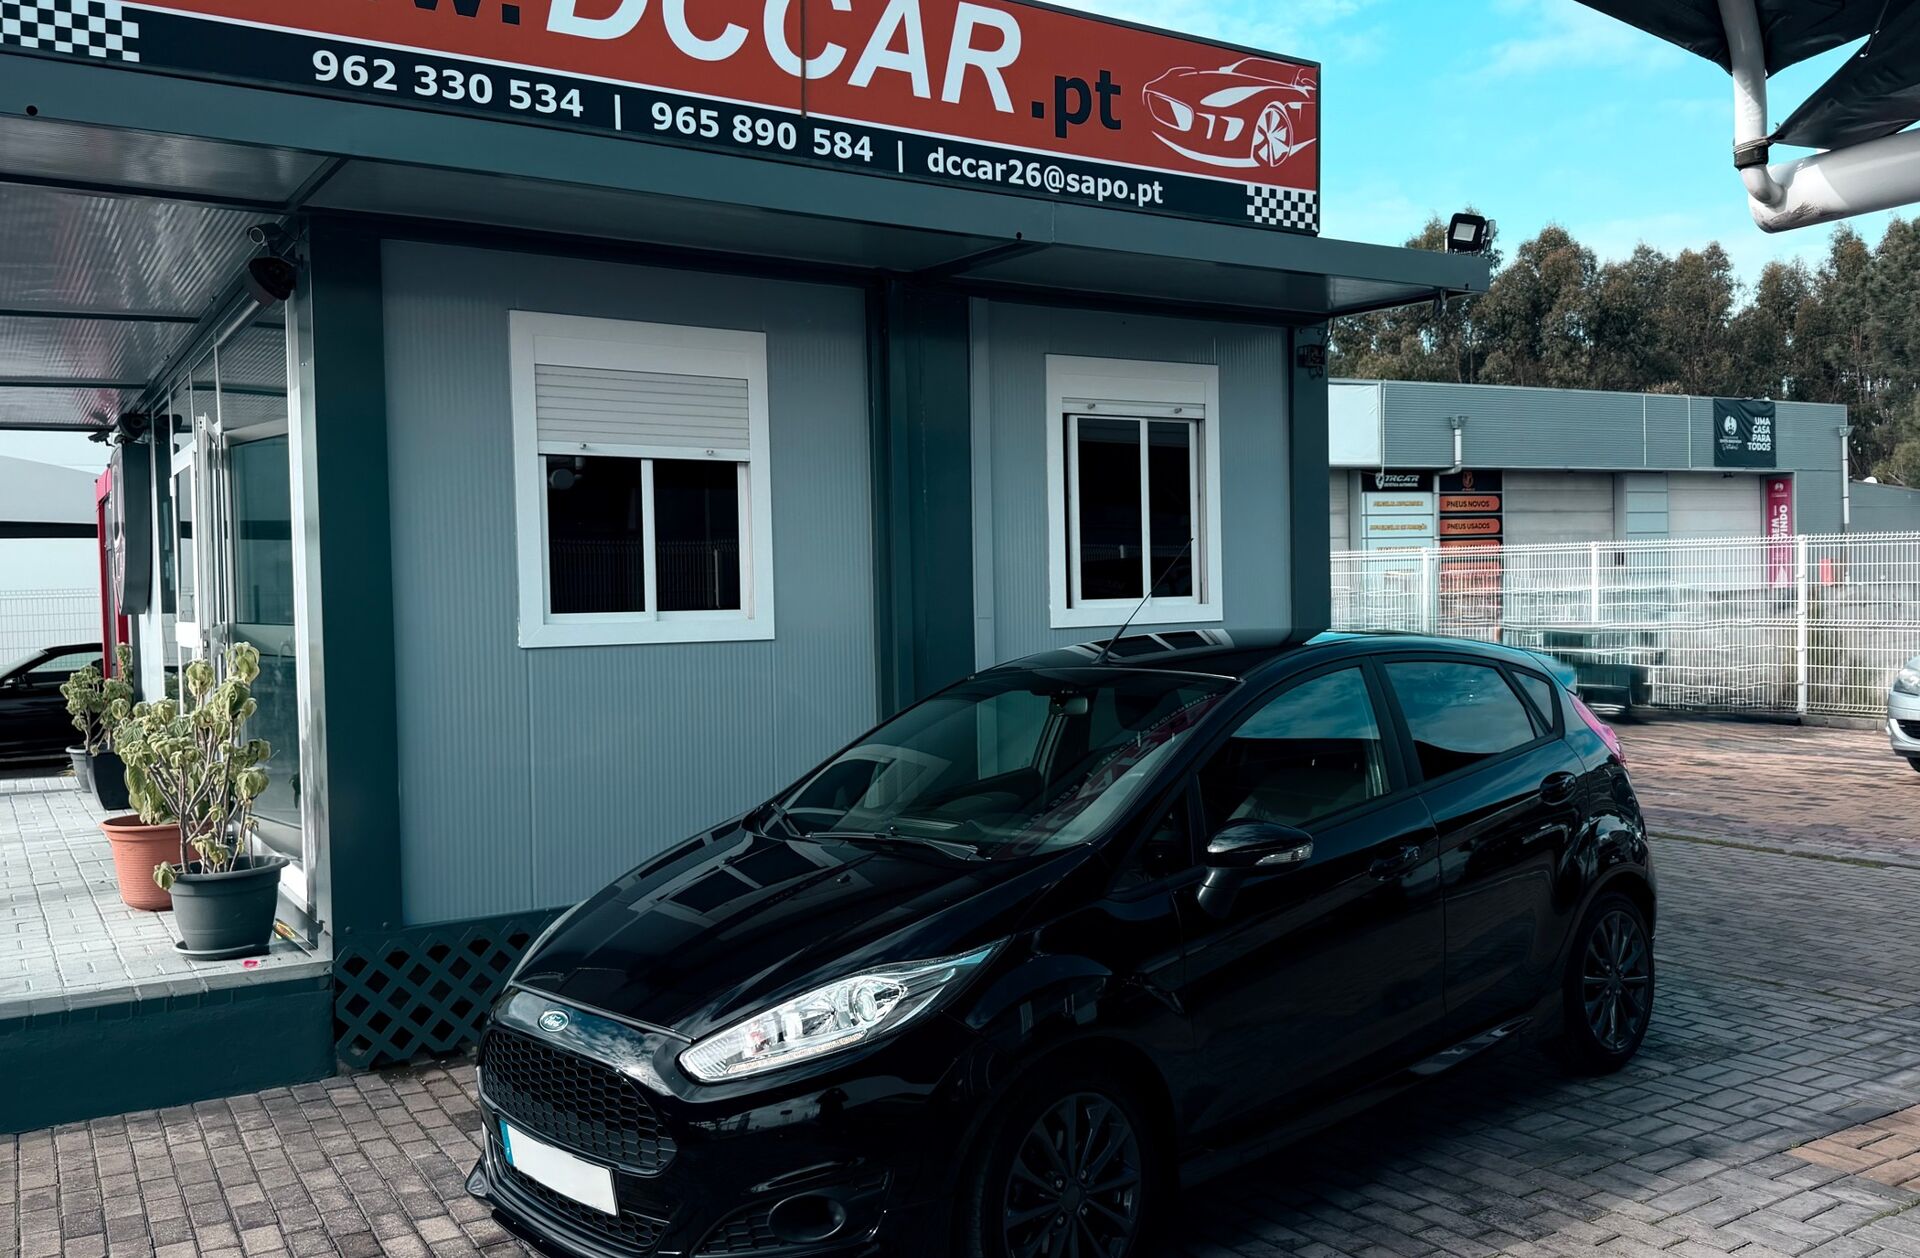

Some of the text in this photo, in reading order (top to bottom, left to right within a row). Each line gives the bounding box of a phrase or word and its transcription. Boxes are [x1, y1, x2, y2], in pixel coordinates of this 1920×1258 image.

[313, 51, 1163, 207] 962 330 534 965 890 584 dccar26@sapo.pt
[1754, 416, 1771, 426] UMA
[1752, 425, 1771, 434] CASA
[1752, 434, 1771, 442] PARA
[1747, 442, 1771, 451] TODOS
[1446, 500, 1490, 508] PNEUS NOVOS
[1467, 522, 1490, 530] USADOS
